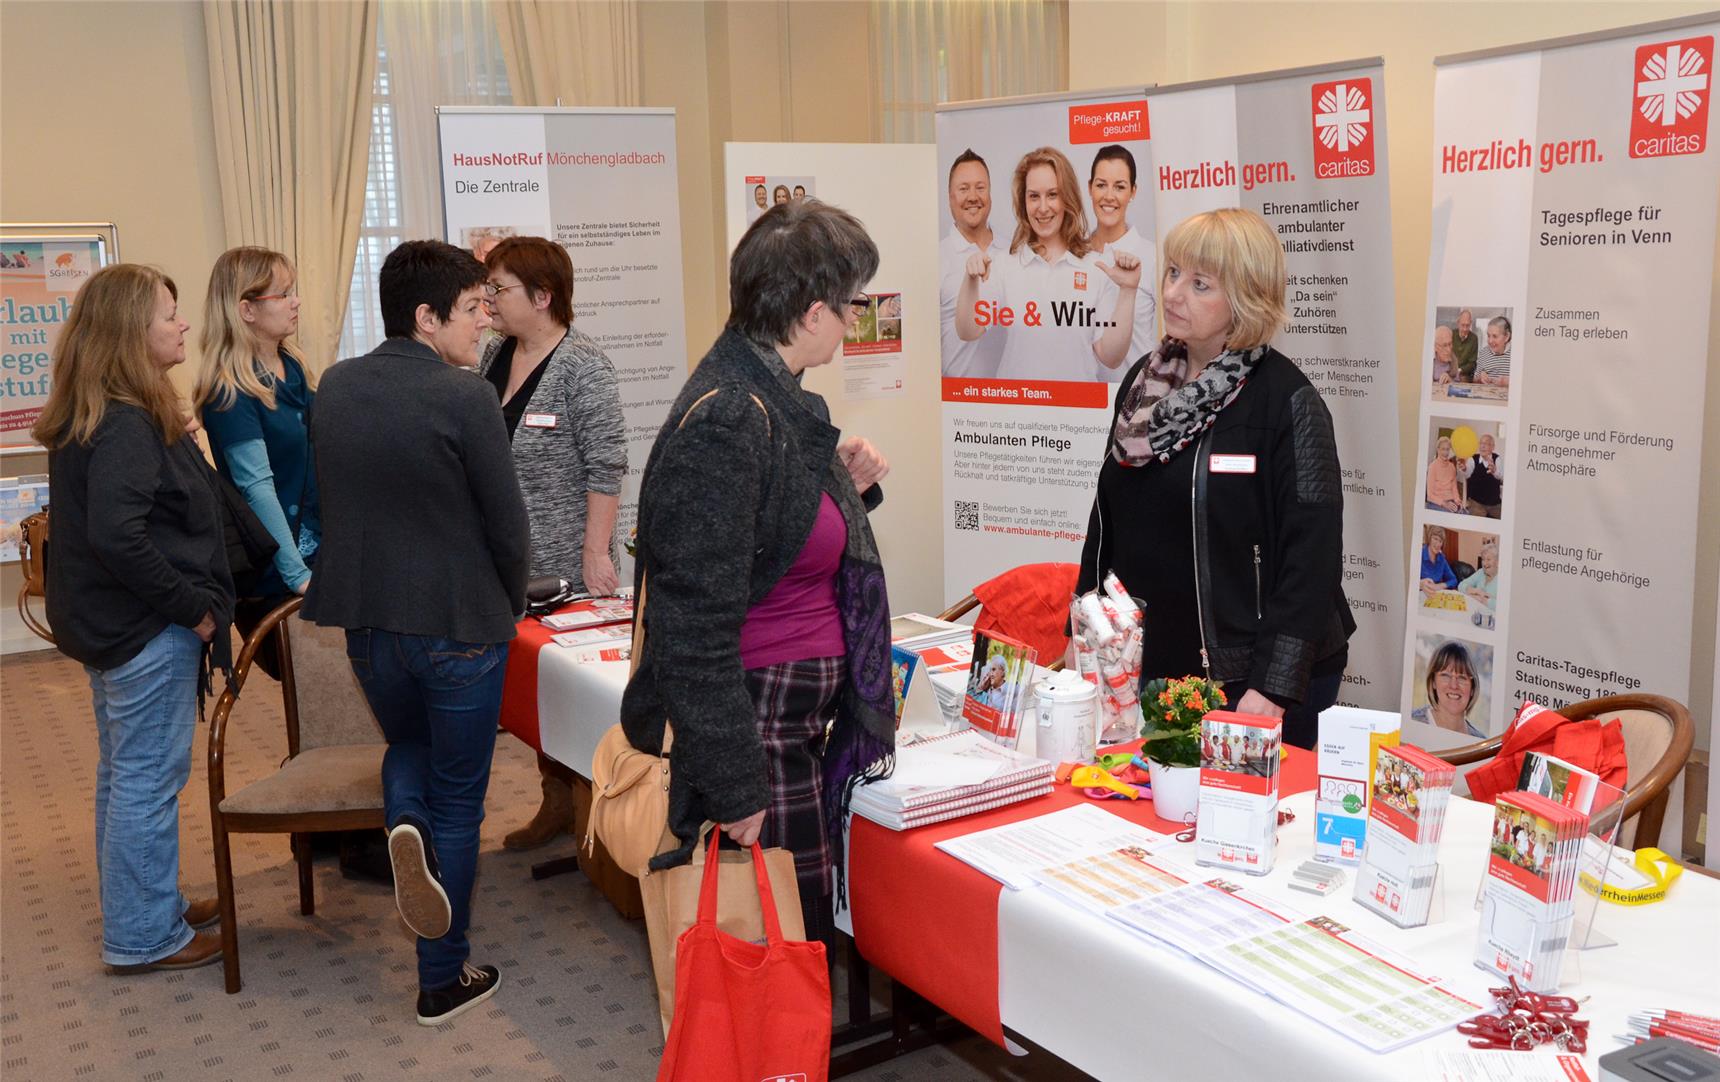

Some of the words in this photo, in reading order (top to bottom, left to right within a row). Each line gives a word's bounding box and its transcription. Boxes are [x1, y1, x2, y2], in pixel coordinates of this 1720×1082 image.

[1073, 109, 1142, 126] Pflege-KRAFT
[1103, 122, 1141, 136] gesucht!
[1634, 132, 1700, 156] caritas
[453, 152, 544, 167] HausNotRuf
[547, 152, 666, 167] Mönchengladbach
[1441, 139, 1532, 174] Herzlich
[1539, 137, 1603, 174] gern.
[1159, 160, 1236, 191] Herzlich
[1242, 161, 1296, 191] gern.
[1318, 157, 1370, 178] caritas
[455, 180, 479, 194] Die
[483, 178, 540, 194] Zentrale
[1263, 199, 1360, 215] Ehrenamtlicher
[1541, 207, 1633, 228] Tagespflege
[1638, 206, 1662, 221] für
[556, 223, 581, 231] Unsere
[581, 222, 608, 230] Zentrale
[629, 221, 661, 229] Sicherheit
[1277, 219, 1346, 234] ambulanter
[1540, 230, 1607, 246] Senioren
[1612, 230, 1626, 245] in
[1631, 229, 1672, 244] Venn
[1300, 274, 1349, 286] schenken
[974, 300, 1015, 328] Sie
[1023, 301, 1042, 327] &
[1051, 301, 1117, 327] Wir...
[1293, 307, 1337, 319] Zuhören
[1535, 307, 1600, 321] Zusammen
[10, 328, 48, 345] mit
[1534, 325, 1555, 337] den
[1559, 325, 1580, 341] Tag
[1583, 326, 1628, 340] erleben
[1304, 356, 1381, 369] schwerstkranker
[1327, 371, 1374, 384] Menschen
[964, 386, 979, 396] ein
[982, 387, 1018, 398] starkes
[1021, 388, 1052, 399] Team.
[1339, 385, 1369, 398] Ehren-
[966, 420, 988, 428] freuen
[954, 431, 1027, 447] Ambulanten
[1032, 435, 1072, 452] Pflege
[1529, 423, 1580, 442] Fürsorge
[1583, 429, 1606, 442] und
[1610, 430, 1674, 452] Förderung
[1528, 441, 1537, 453] in
[1541, 443, 1616, 461] angenehmer
[1355, 468, 1366, 480] für
[1526, 458, 1597, 478] Atmosphäre
[1376, 484, 1385, 496] in
[982, 502, 1018, 514] Bewerben
[1020, 505, 1032, 514] Sie
[1034, 506, 1049, 516] sich
[982, 513, 1013, 525] Bequem
[1014, 516, 1028, 525] und
[1030, 517, 1057, 528] einfach
[1522, 538, 1584, 562] Entlastung
[1586, 547, 1603, 561] für
[1350, 555, 1381, 568] Entlas-
[1521, 556, 1578, 576] pflegende
[1580, 565, 1651, 589] Angehörige
[1378, 604, 1388, 613] im
[1516, 651, 1641, 689] Caritas-Tagespflege
[1515, 670, 1591, 699] Stationsweg
[1514, 689, 1549, 707] 41068
